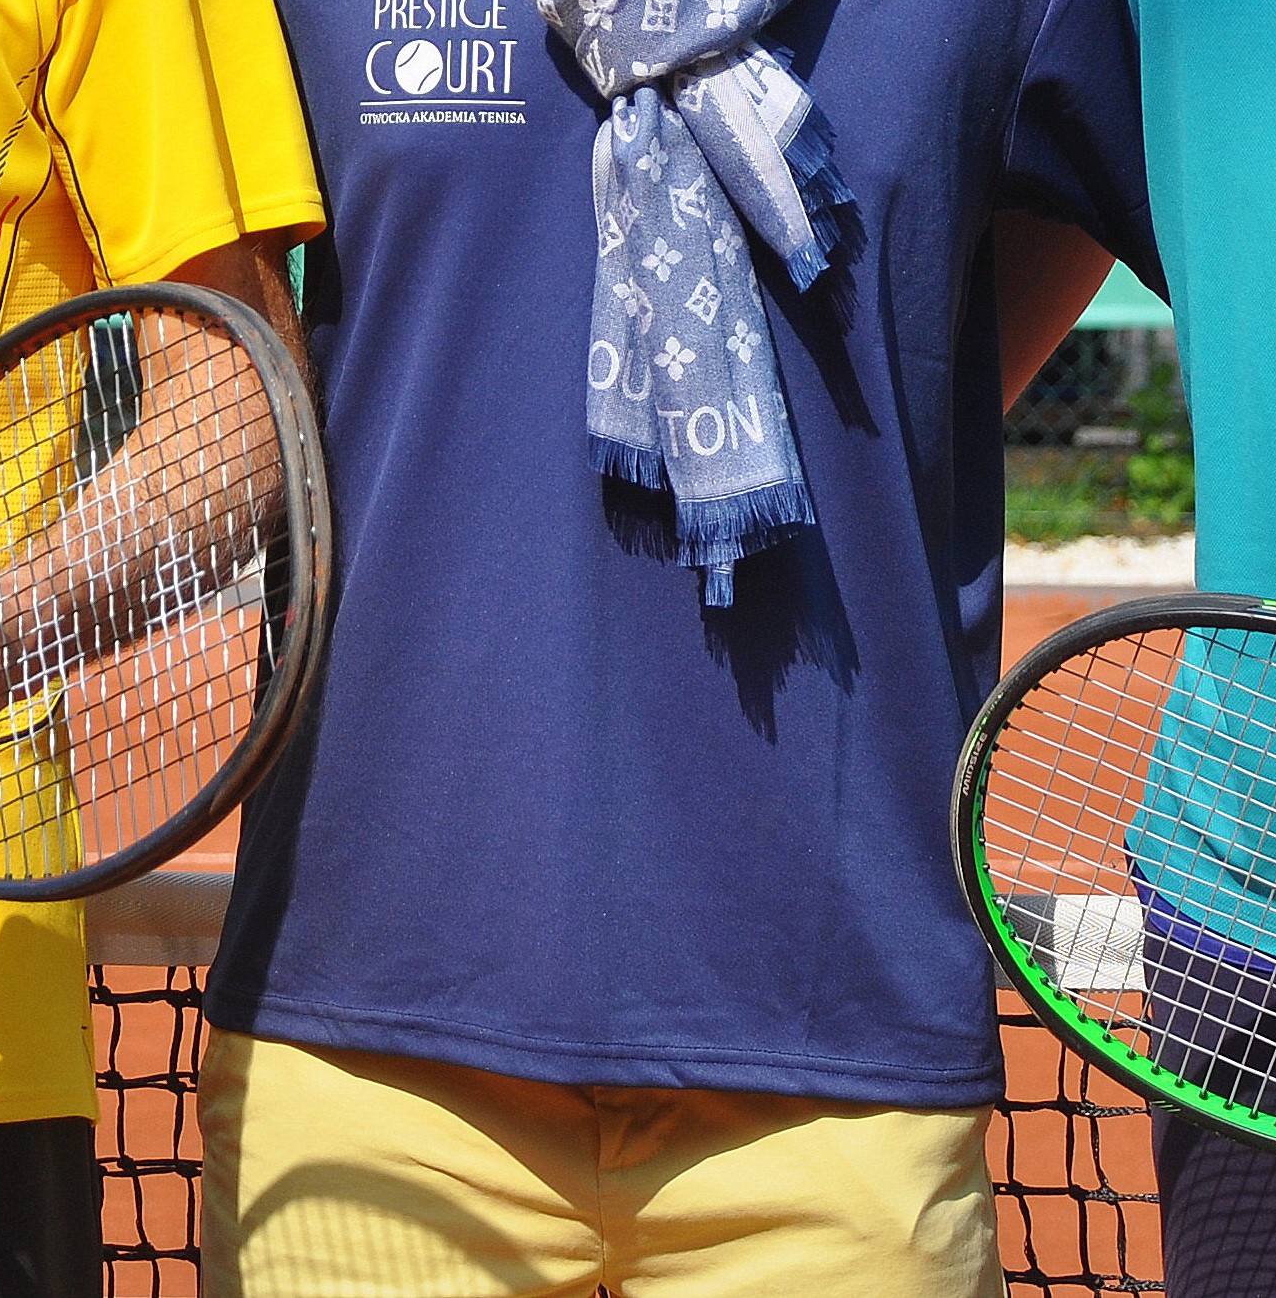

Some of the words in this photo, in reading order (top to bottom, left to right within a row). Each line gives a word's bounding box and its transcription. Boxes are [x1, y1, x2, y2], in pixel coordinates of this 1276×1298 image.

[365, 39, 518, 95] COURT
[360, 112, 411, 125] OTWOCKA
[412, 111, 479, 124] AKADEMIA
[478, 111, 526, 124] TENISA
